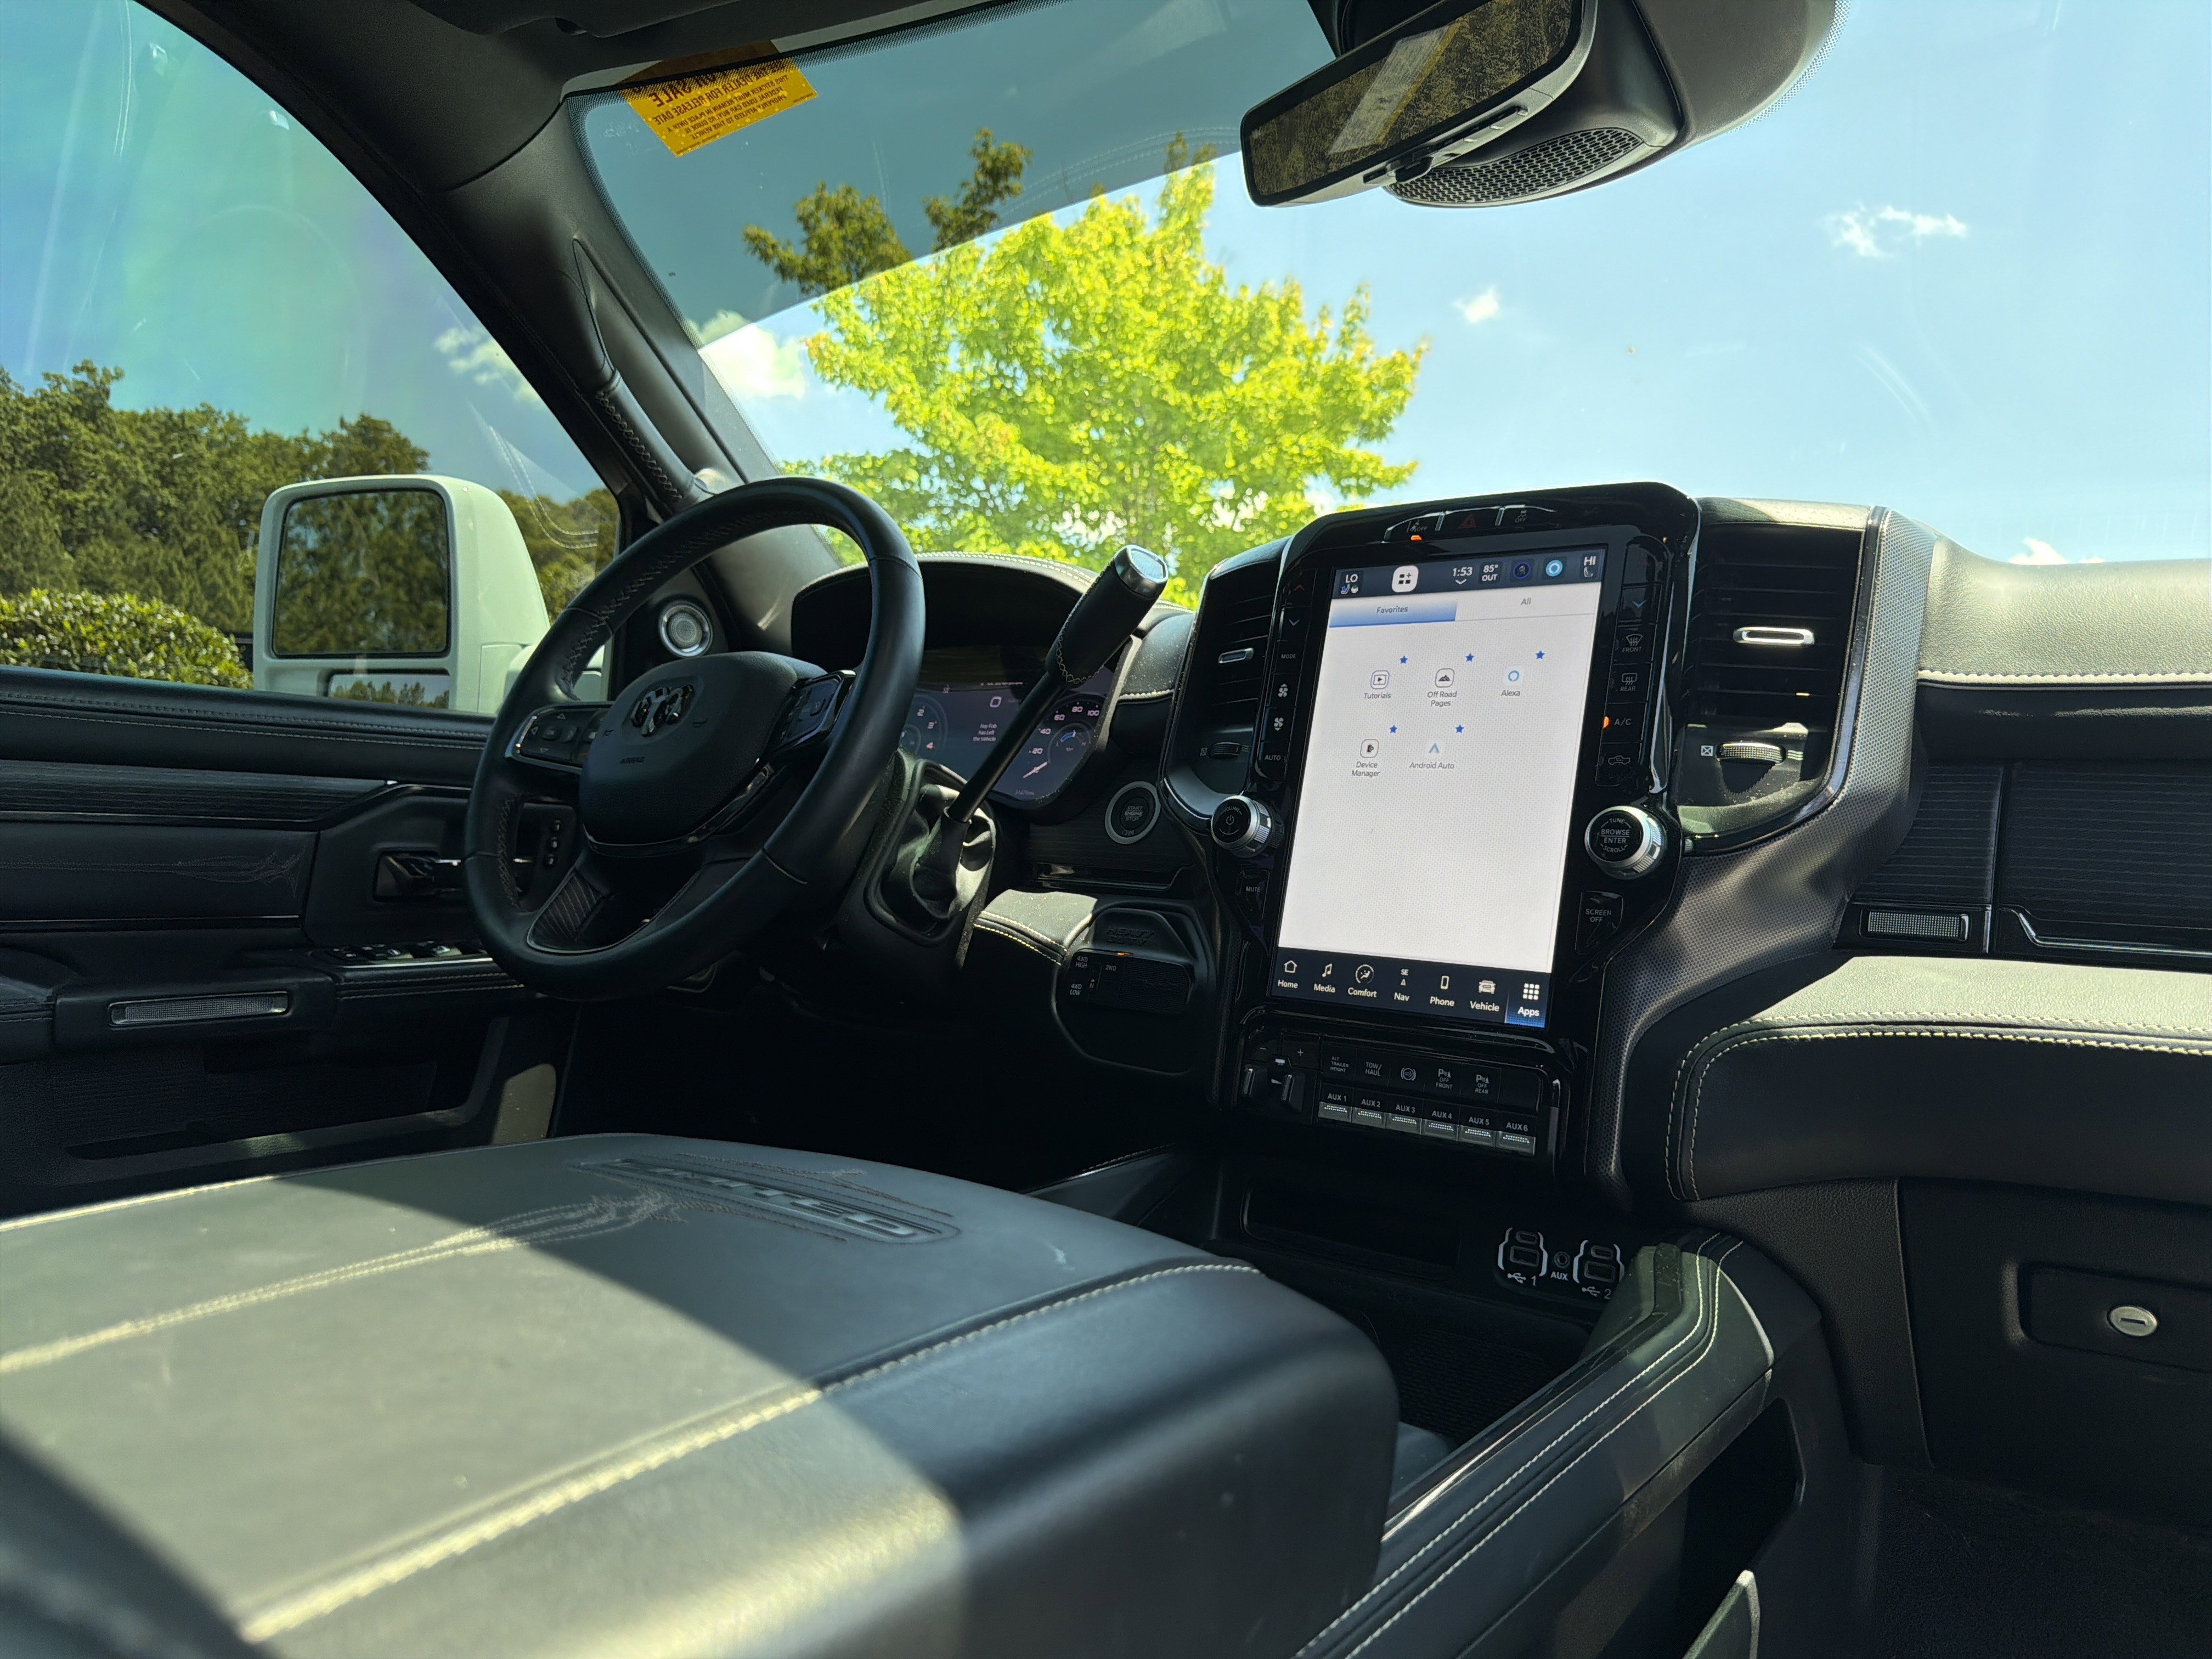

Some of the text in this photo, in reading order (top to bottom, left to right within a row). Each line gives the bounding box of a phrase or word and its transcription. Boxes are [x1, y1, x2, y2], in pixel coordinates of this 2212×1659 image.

[1584, 556, 1596, 566] HI
[1453, 566, 1473, 577] 1:53
[1483, 564, 1499, 573] 85°
[1345, 574, 1358, 583] LO
[1481, 573, 1498, 582] OUT
[1376, 606, 1408, 614] Favorites
[1602, 845, 1626, 853] SCROLL
[1278, 980, 1298, 989] Home
[1313, 984, 1335, 993] Media
[1347, 988, 1377, 998] Comfort
[1394, 992, 1409, 1001] Nav
[1430, 996, 1454, 1007] Phone
[1470, 1001, 1499, 1012] Vehicle
[1517, 1006, 1539, 1017] Apps
[1365, 1062, 1382, 1070] TOW/
[1365, 1068, 1381, 1076] HAUL
[1327, 1092, 1342, 1101] AUX
[1395, 1104, 1410, 1112] AUX
[1431, 1110, 1447, 1119] AUX
[1468, 1116, 1484, 1125] AUX
[1505, 1122, 1528, 1132] AUX 6
[1531, 1275, 1536, 1286] 1
[1550, 1271, 1569, 1281] AUX
[1604, 1288, 1611, 1300] 2
